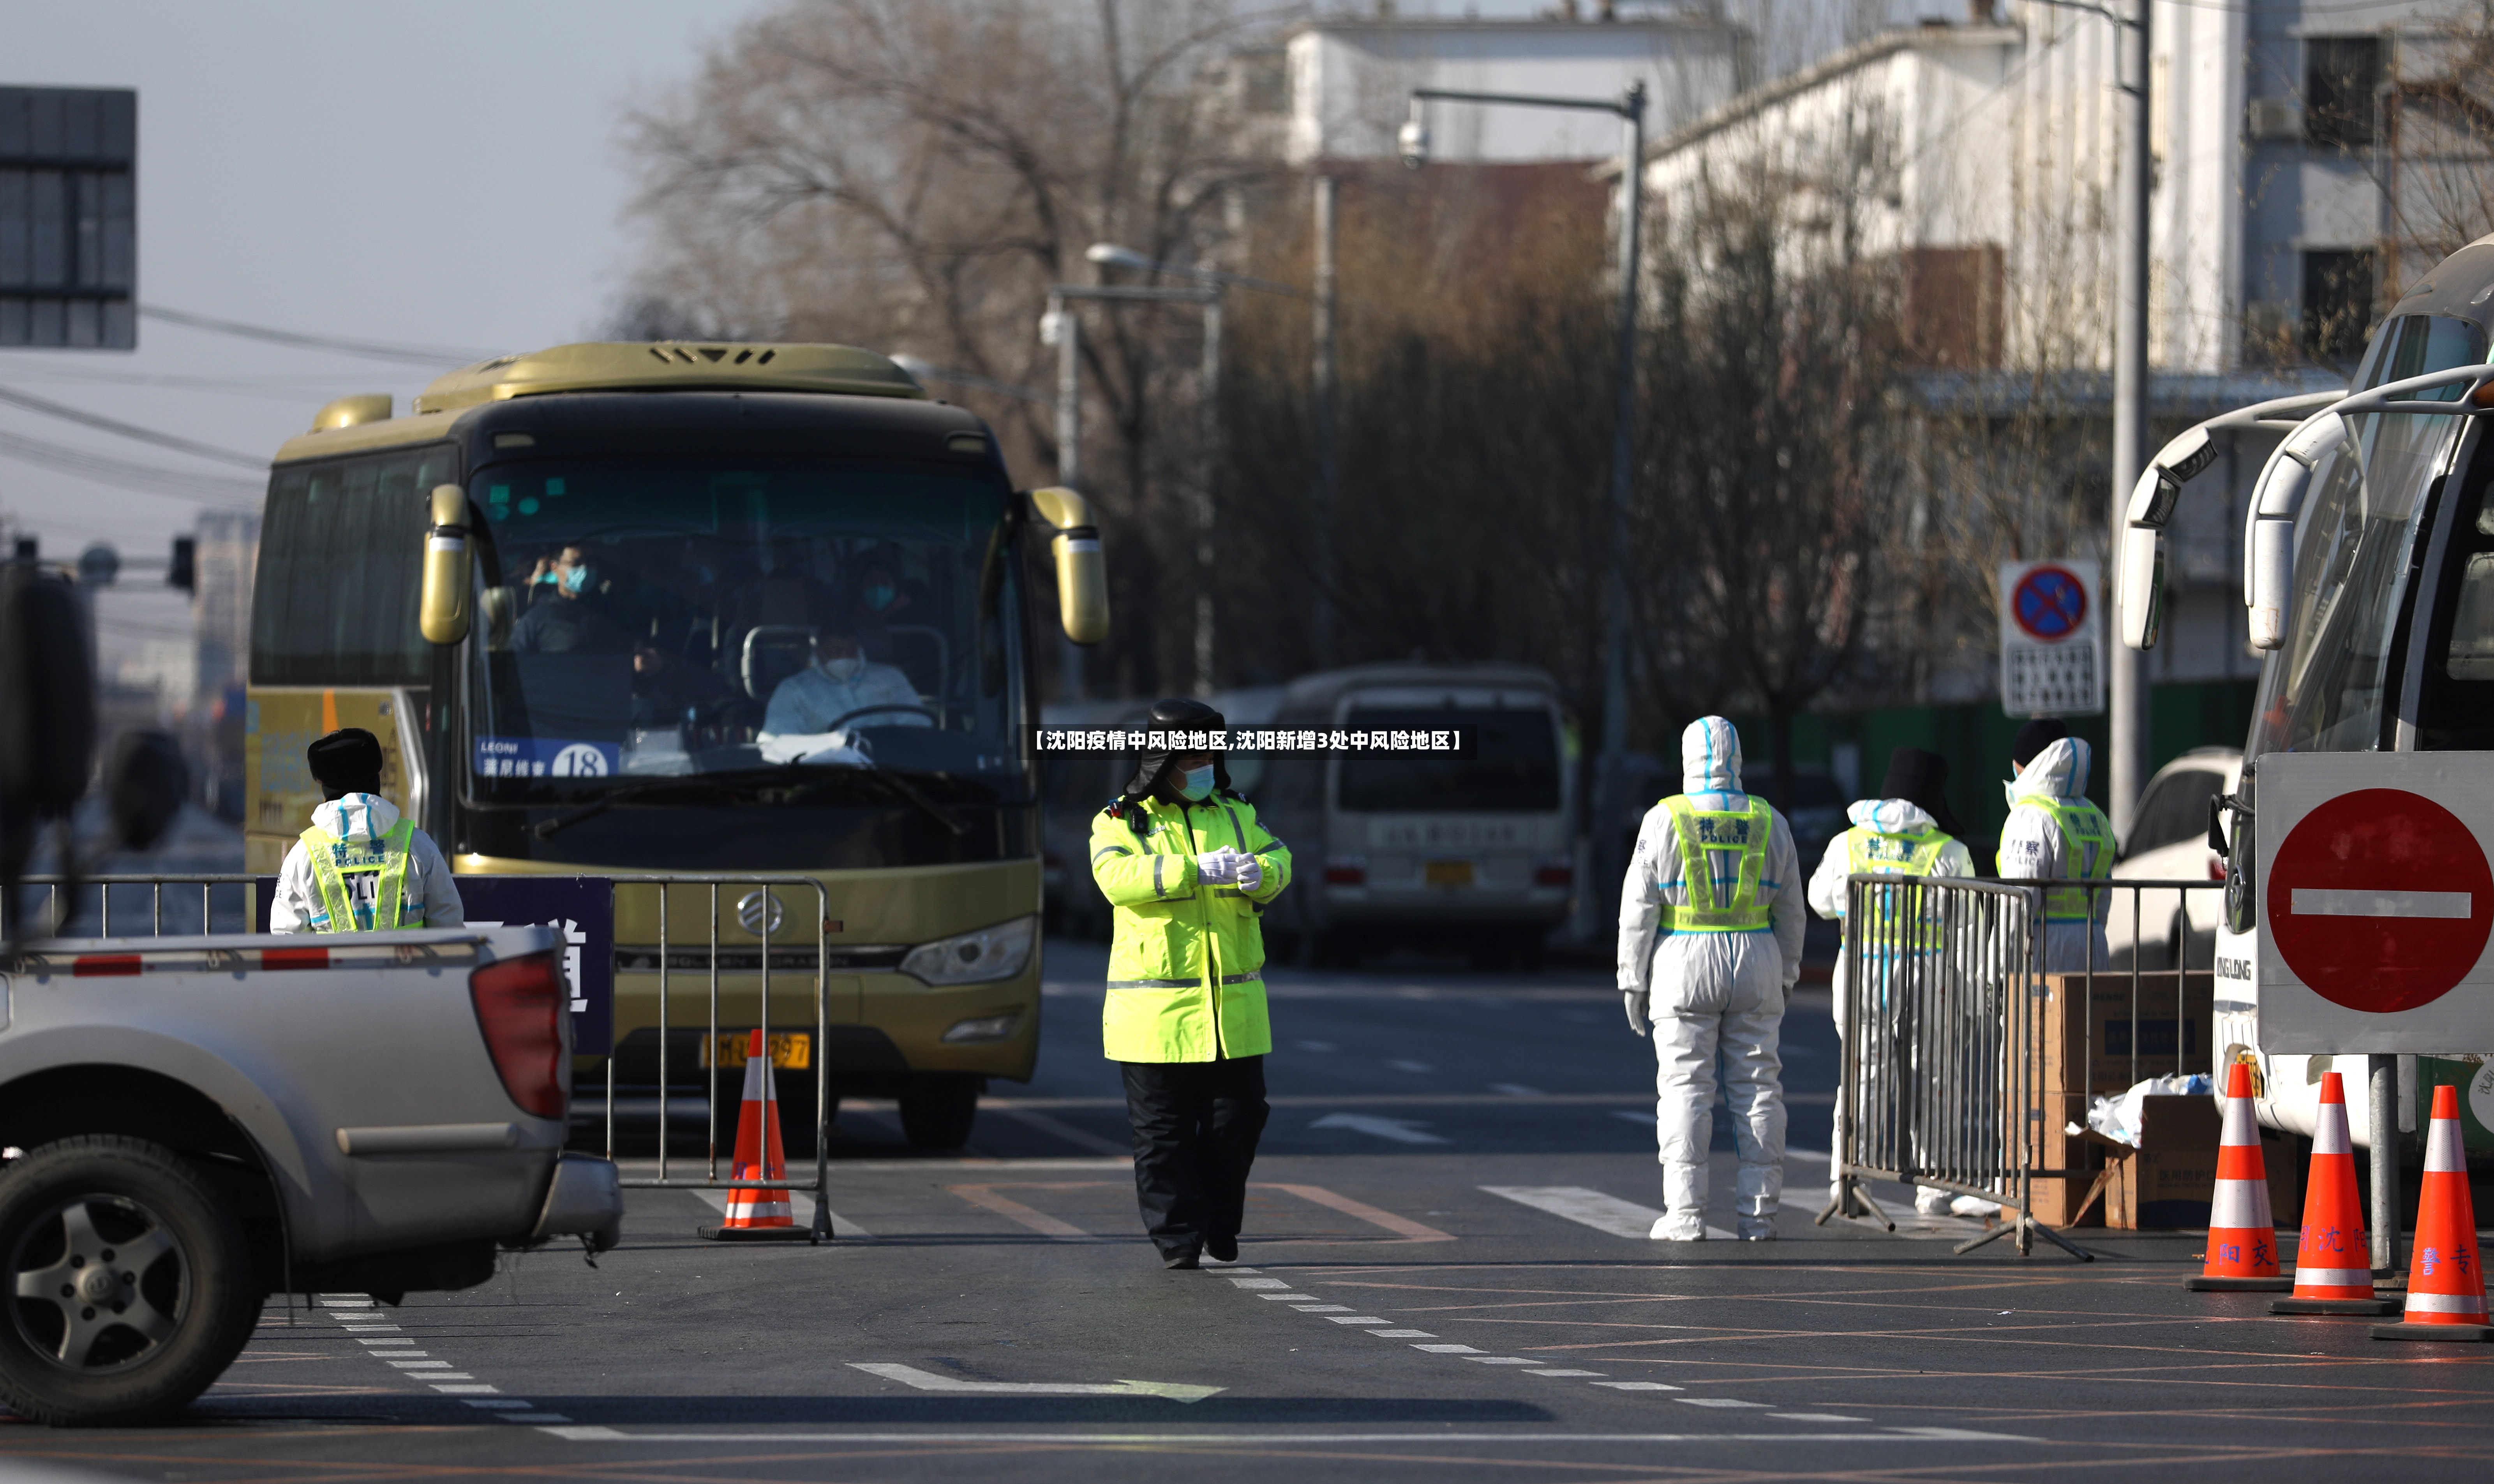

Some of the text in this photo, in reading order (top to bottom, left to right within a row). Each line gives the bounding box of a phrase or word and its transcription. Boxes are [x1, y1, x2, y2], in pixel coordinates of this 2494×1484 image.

[481, 741, 519, 754] LEONI
[564, 750, 598, 778] 18
[332, 839, 385, 858] 特警
[1702, 834, 1747, 844] POLICE
[335, 855, 385, 866] POLICE
[2229, 959, 2251, 981] LONG
[2409, 1244, 2471, 1276] 警专
